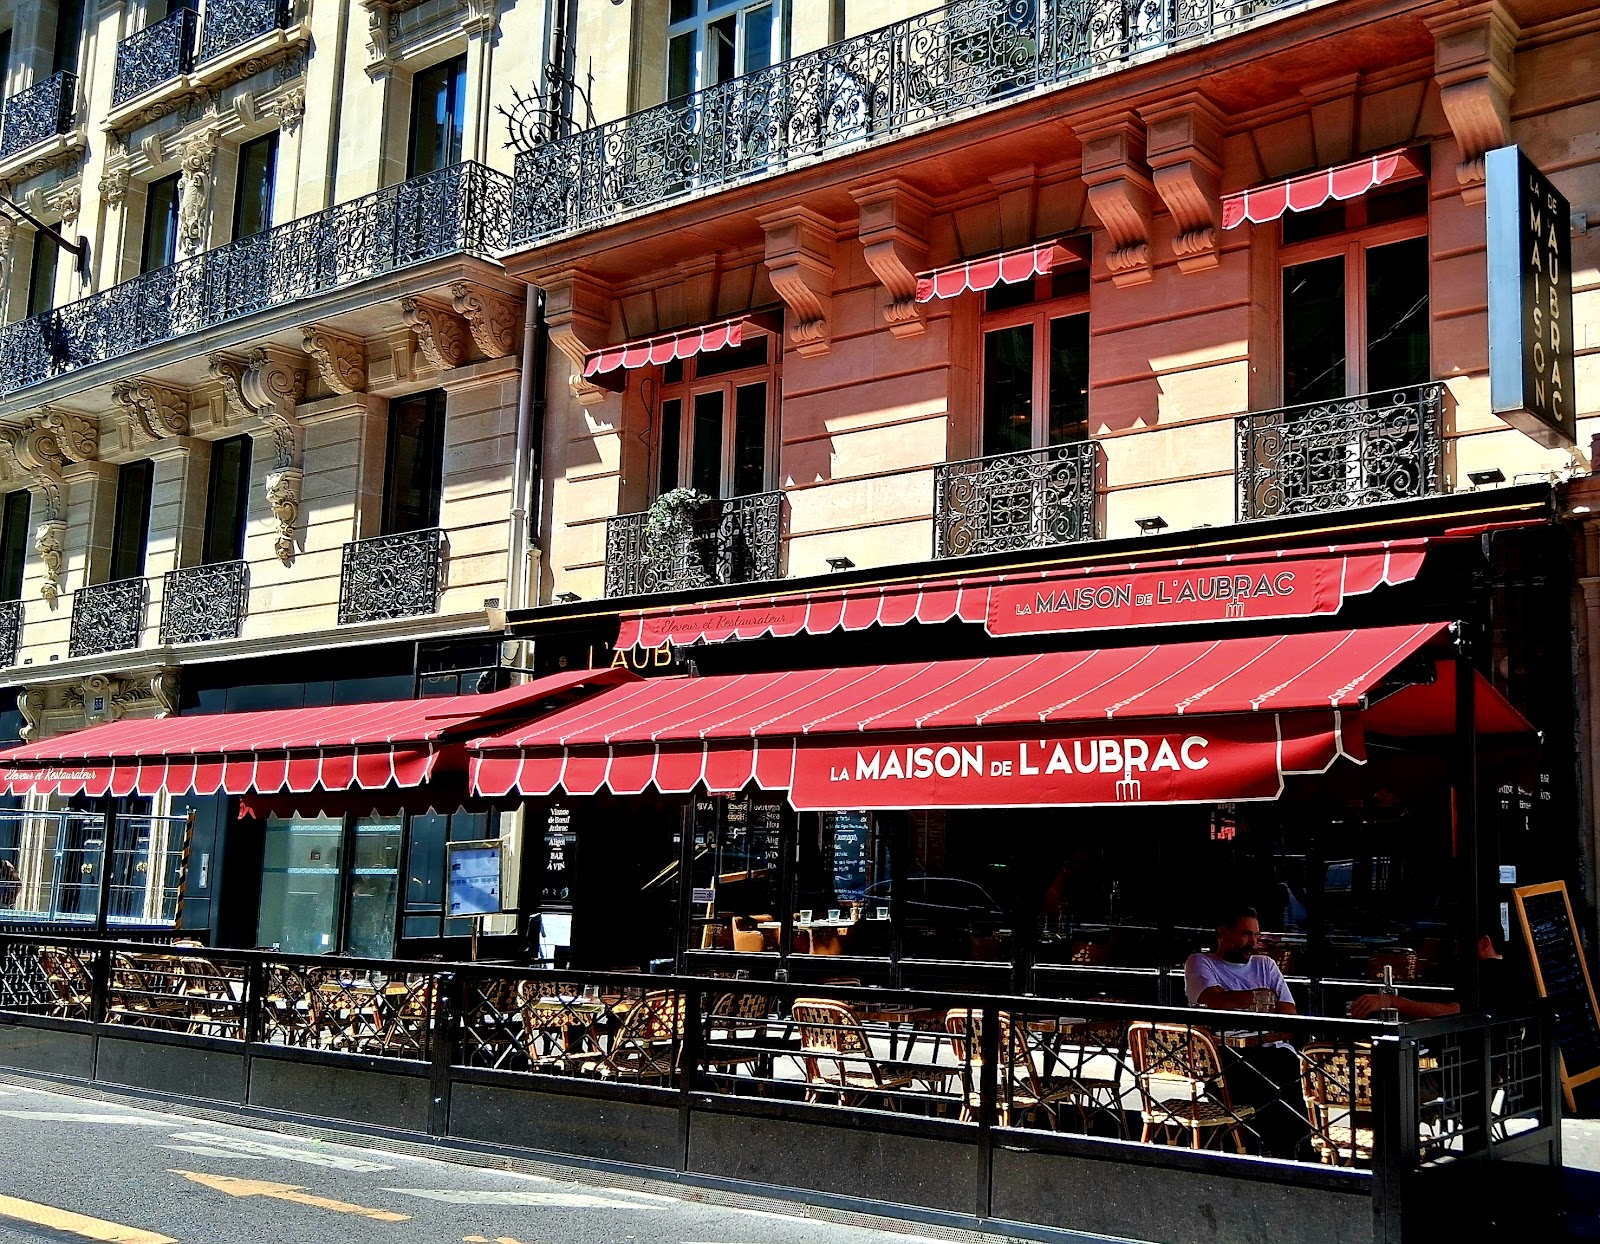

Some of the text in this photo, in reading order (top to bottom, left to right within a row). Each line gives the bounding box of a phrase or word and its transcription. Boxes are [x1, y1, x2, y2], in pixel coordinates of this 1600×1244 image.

[1547, 193, 1558, 215] DE
[1529, 174, 1547, 411] LA MAISON
[1015, 571, 1296, 616] LA MAISON DE L'AUBRAC
[702, 618, 714, 630] et
[716, 613, 788, 629] Restaurateur
[35, 768, 45, 780] et
[44, 766, 97, 781] Restaurateur
[830, 735, 1210, 782] LA MAISON DE L'AUBRAC
